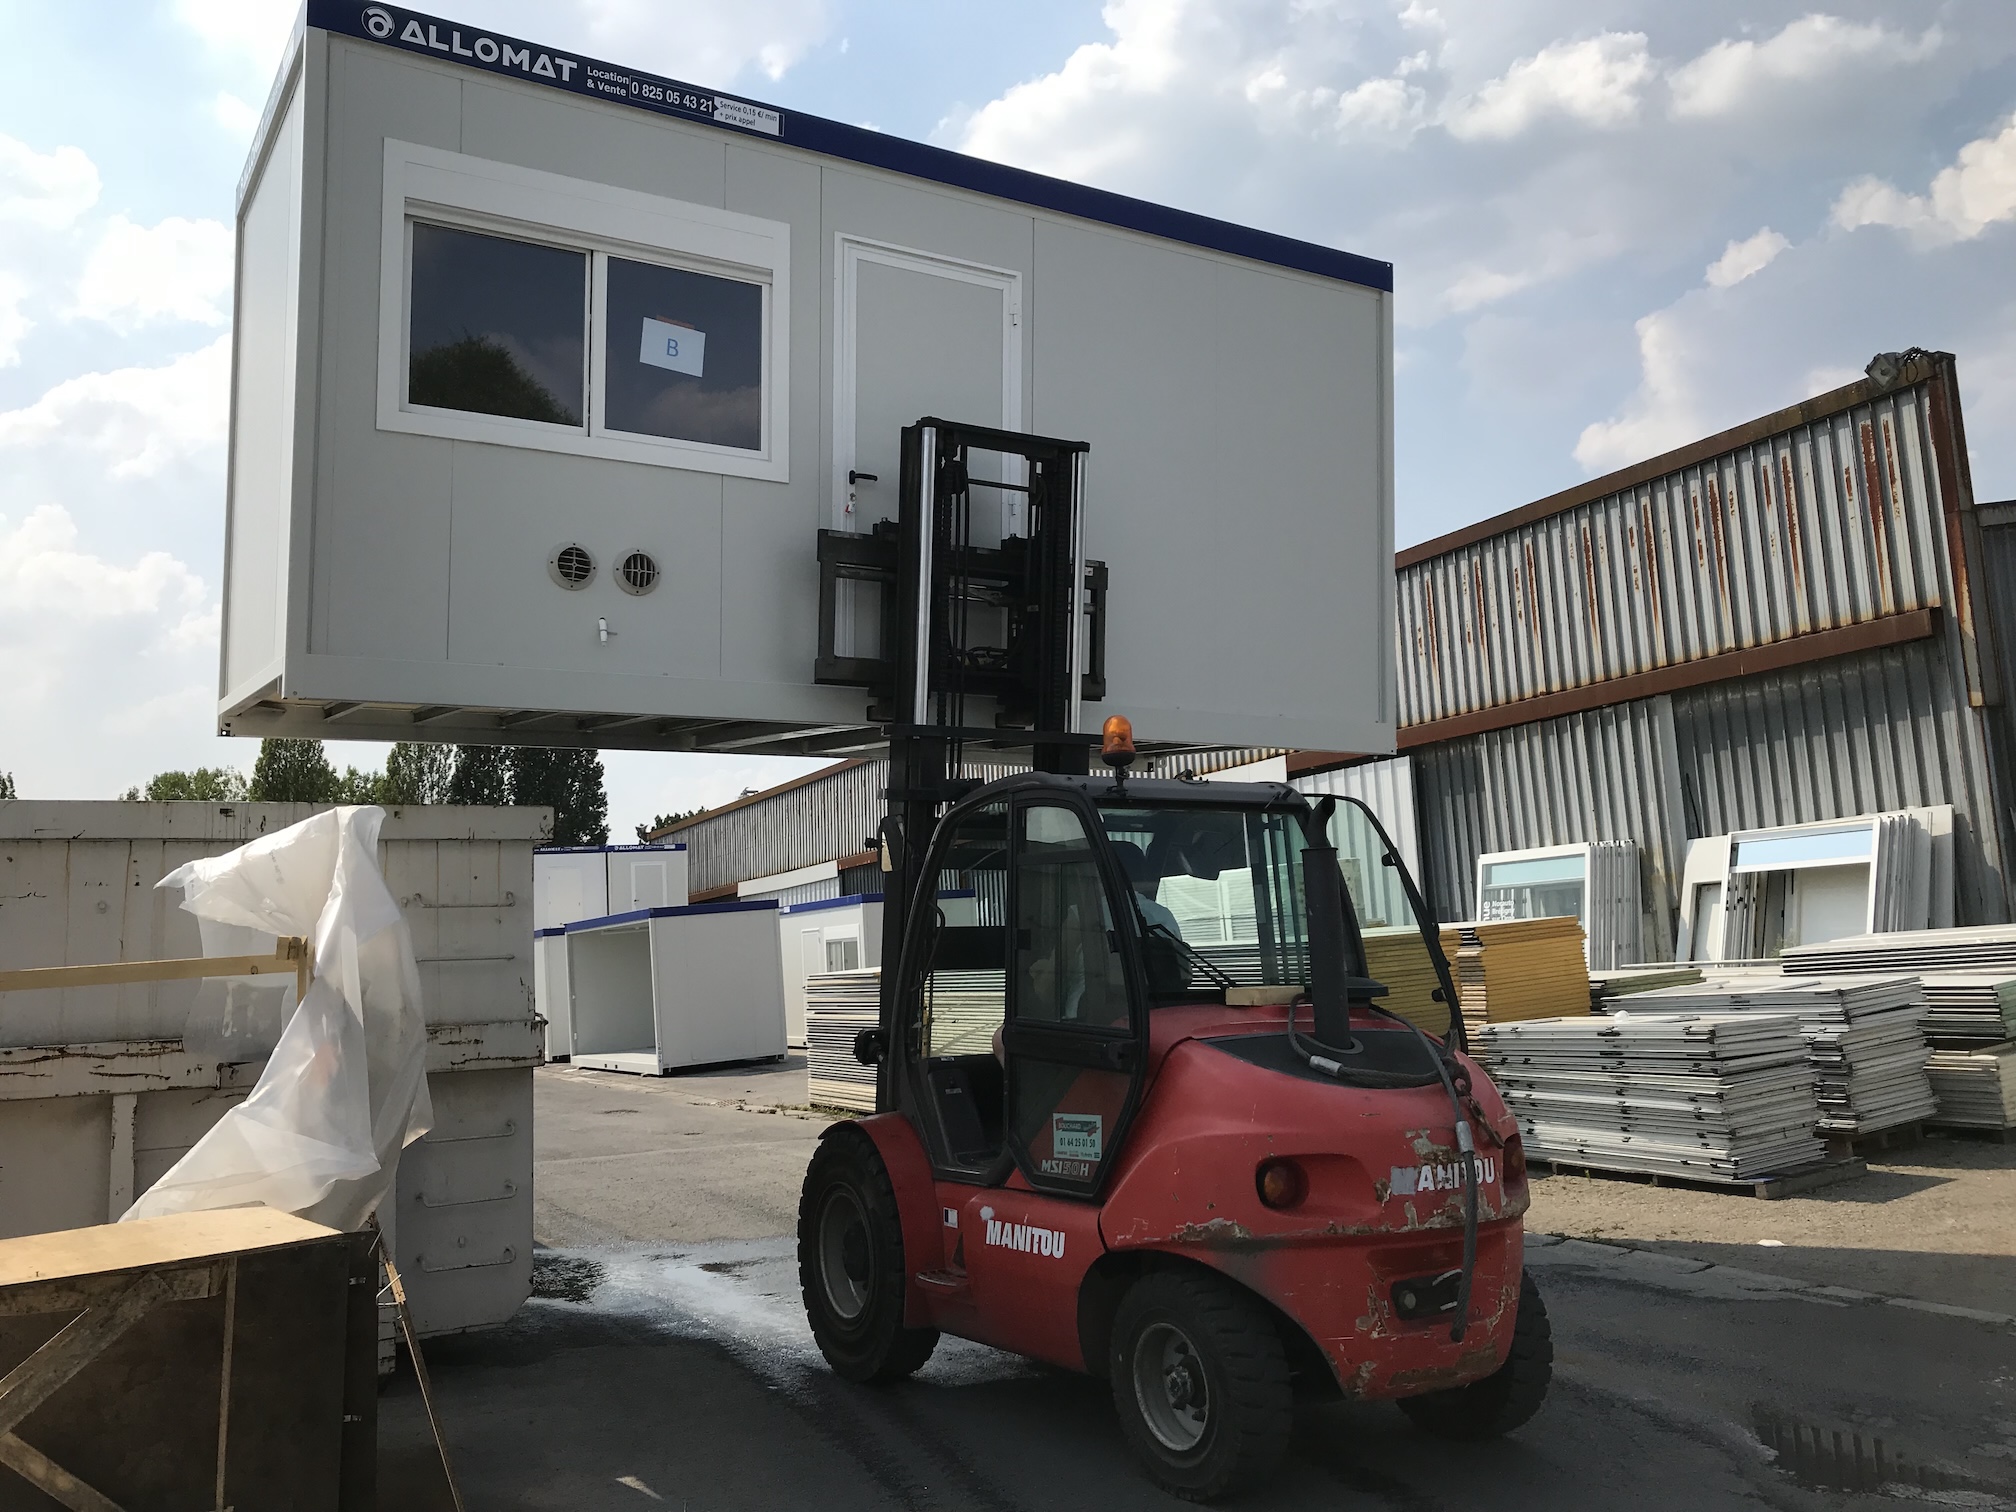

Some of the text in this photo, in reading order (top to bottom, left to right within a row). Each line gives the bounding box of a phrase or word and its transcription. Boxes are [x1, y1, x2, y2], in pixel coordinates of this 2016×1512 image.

[400, 19, 578, 82] ALLOMAT
[587, 66, 629, 85] Location
[586, 79, 627, 97] & Vente
[631, 81, 713, 113] 0 825 05 43 21
[719, 100, 741, 113] Service
[742, 106, 756, 116] 0,15
[725, 113, 738, 121] prix
[738, 116, 756, 126] appel
[666, 338, 679, 357] B
[985, 1219, 1066, 1259] MANITOU
